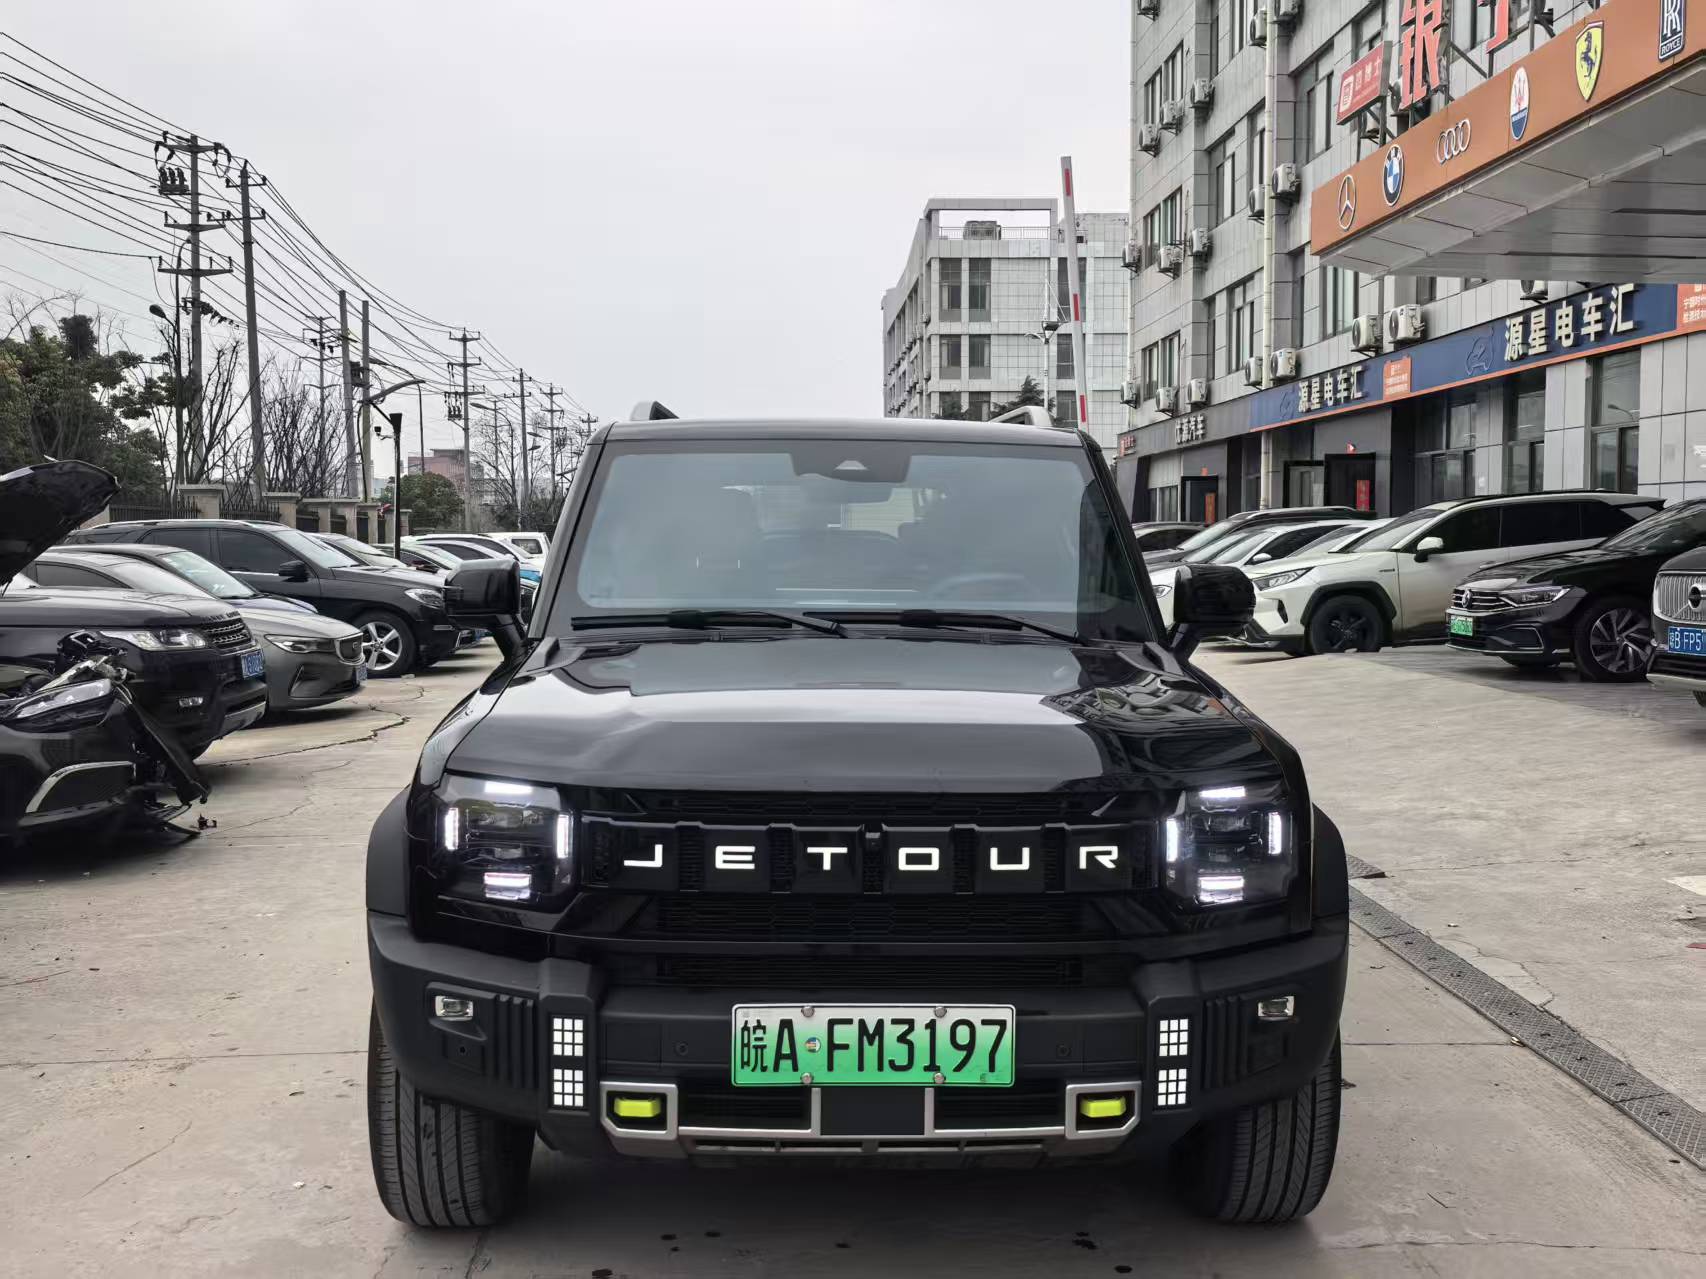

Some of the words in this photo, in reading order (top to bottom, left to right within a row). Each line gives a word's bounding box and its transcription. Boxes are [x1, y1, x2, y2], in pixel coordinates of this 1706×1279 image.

[1661, 37, 1681, 55] ROYCE
[1504, 283, 1634, 361] 源星电车汇
[1298, 365, 1362, 413] 源星电车汇
[1684, 632, 1704, 651] FP5
[623, 844, 1119, 871] JETOUR
[740, 1018, 799, 1073] 皖A
[827, 1018, 1008, 1073] FM3197
